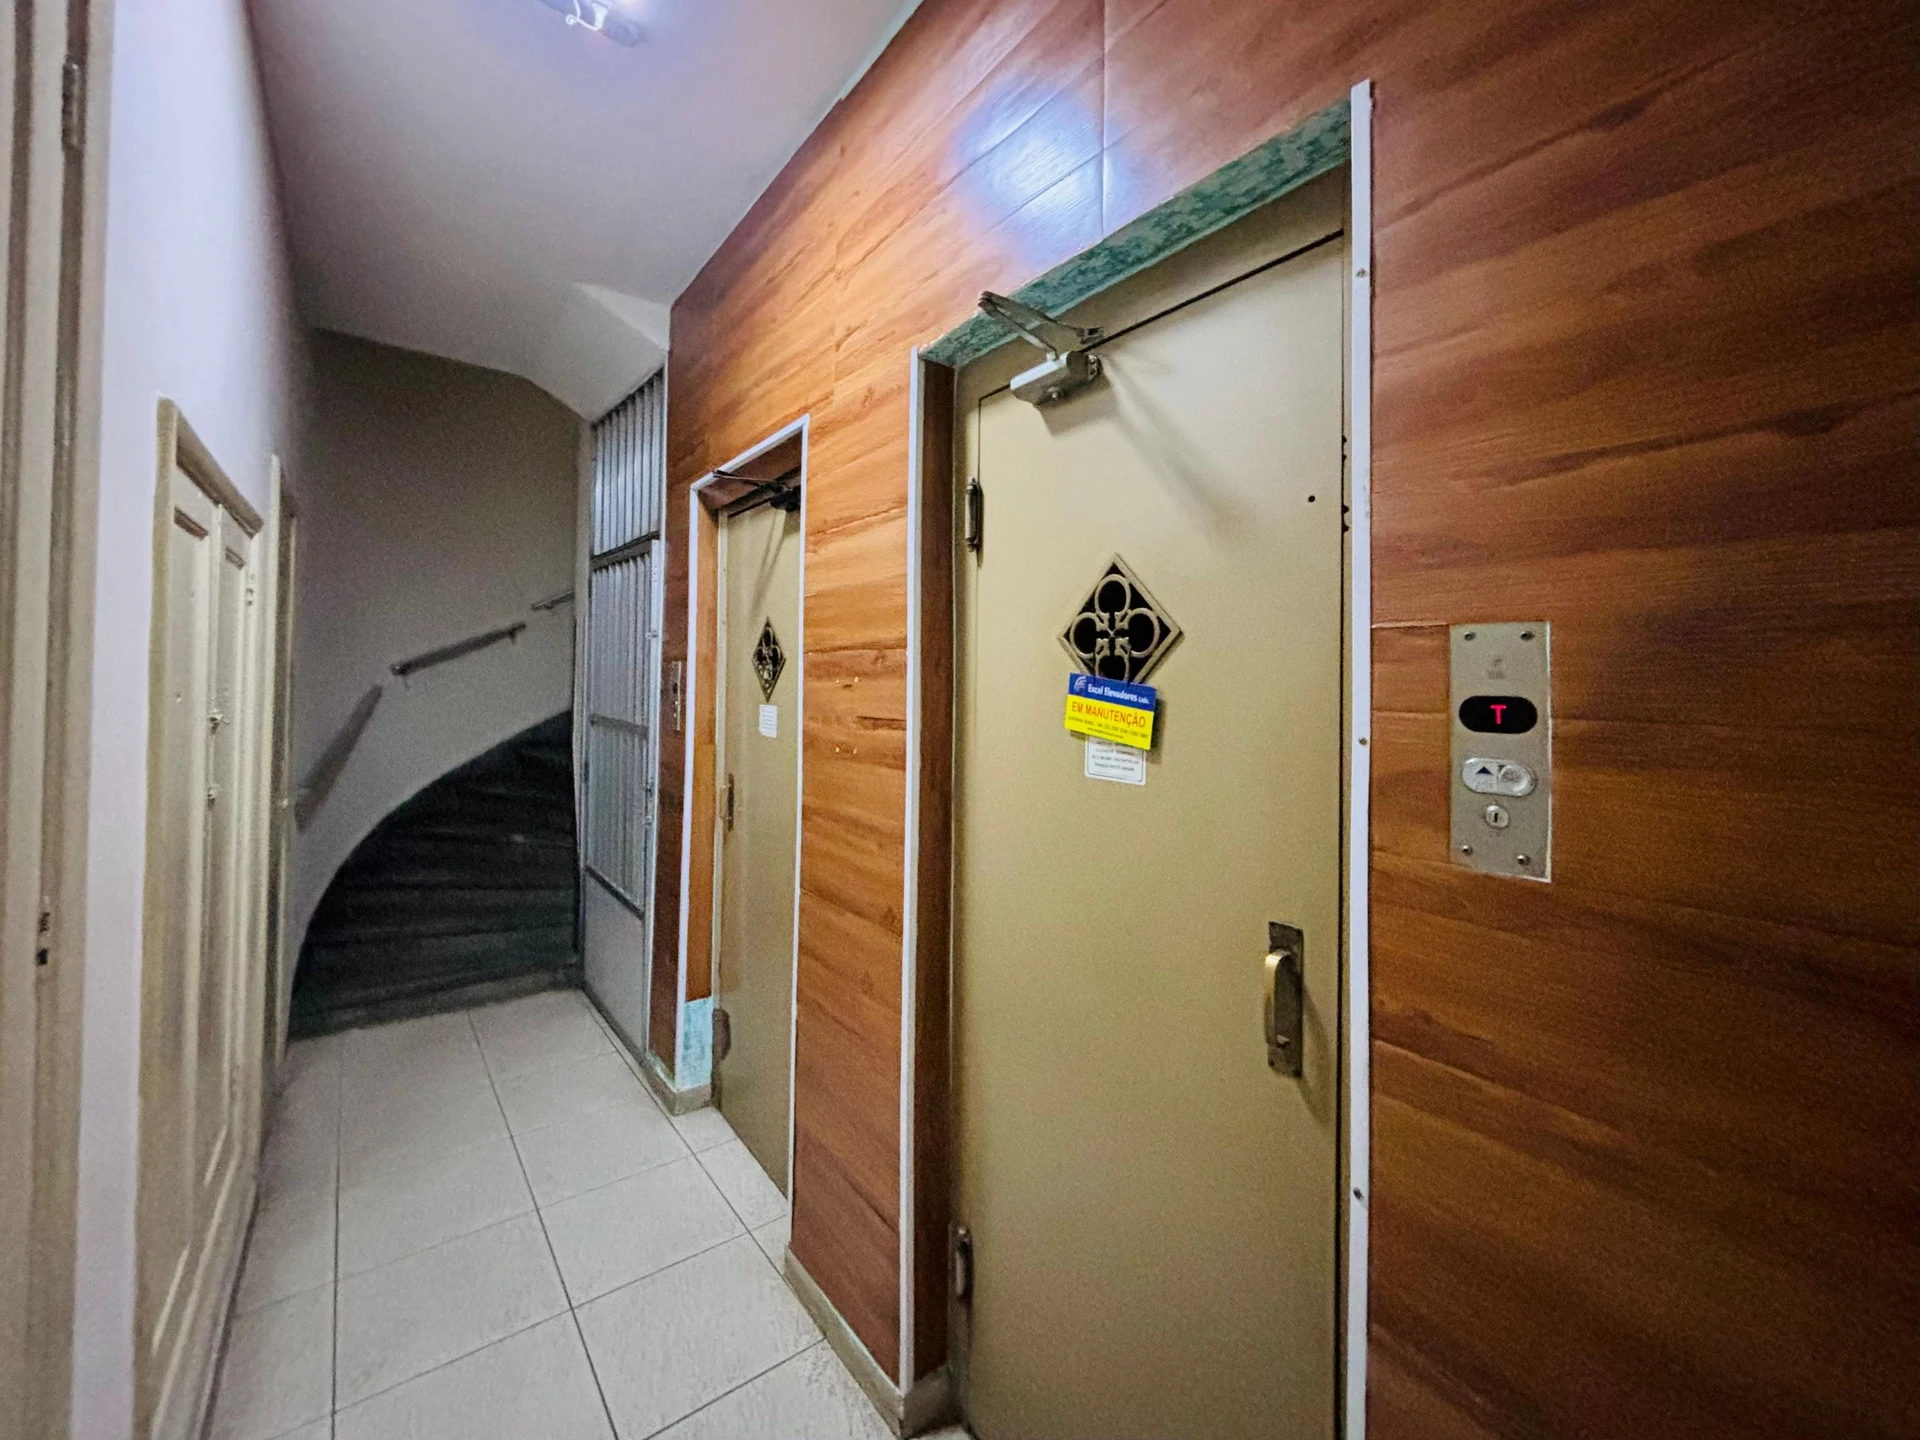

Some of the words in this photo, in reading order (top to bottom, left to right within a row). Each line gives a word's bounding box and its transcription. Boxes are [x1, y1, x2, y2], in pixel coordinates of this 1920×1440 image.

[1087, 683, 1103, 695] Excel
[1104, 686, 1138, 702] Elevadores
[1071, 701, 1084, 713] EM
[1085, 704, 1146, 728] MANUTENÇÃO
[1490, 704, 1507, 725] T
